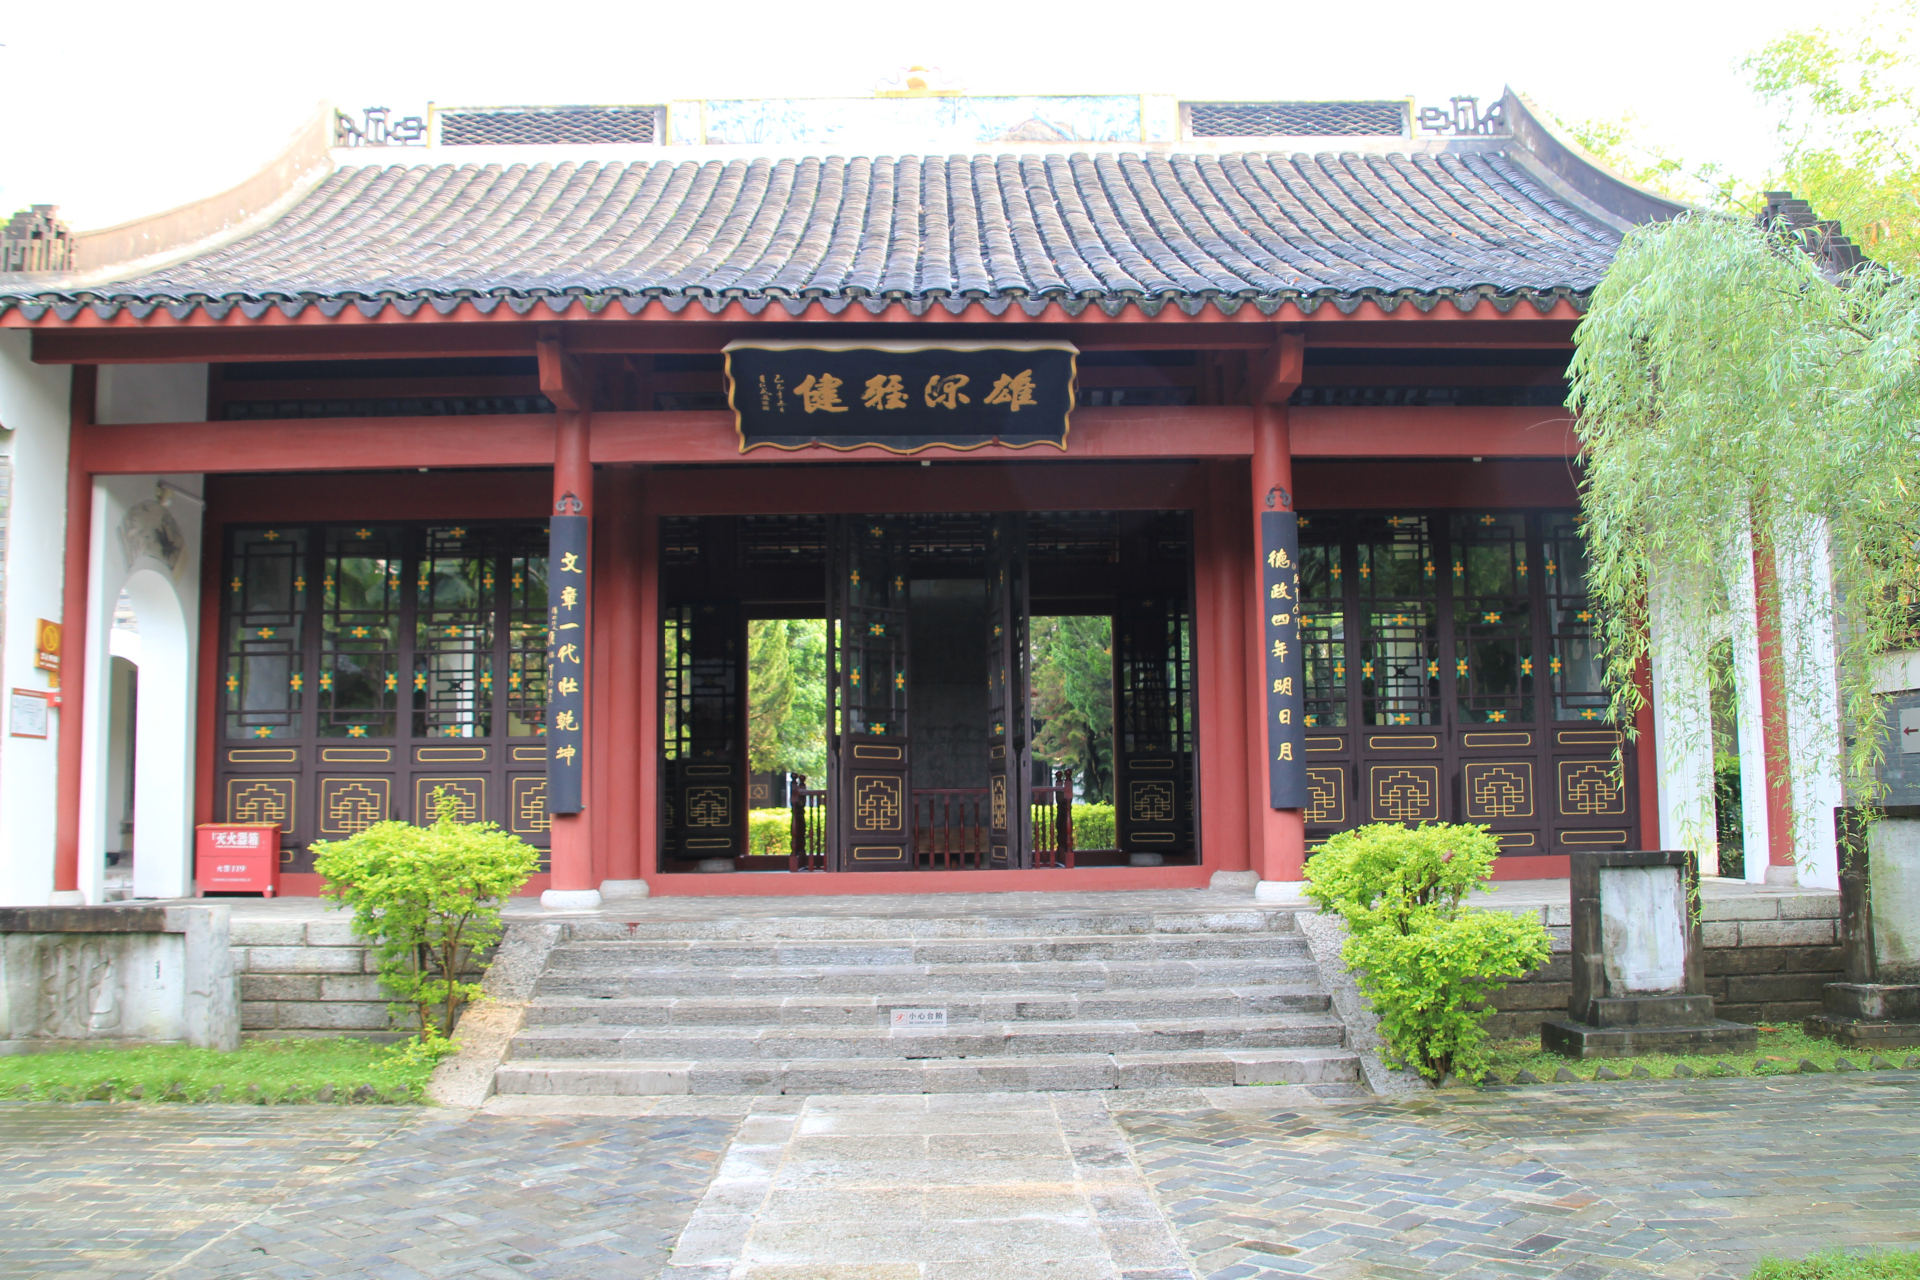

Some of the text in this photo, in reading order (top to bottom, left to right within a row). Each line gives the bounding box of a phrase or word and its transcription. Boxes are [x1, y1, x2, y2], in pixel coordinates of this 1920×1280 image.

[1267, 548, 1293, 762] 德政四年明日月
[215, 832, 259, 845] 灭火器箱
[909, 1012, 943, 1020] 小心台阶
